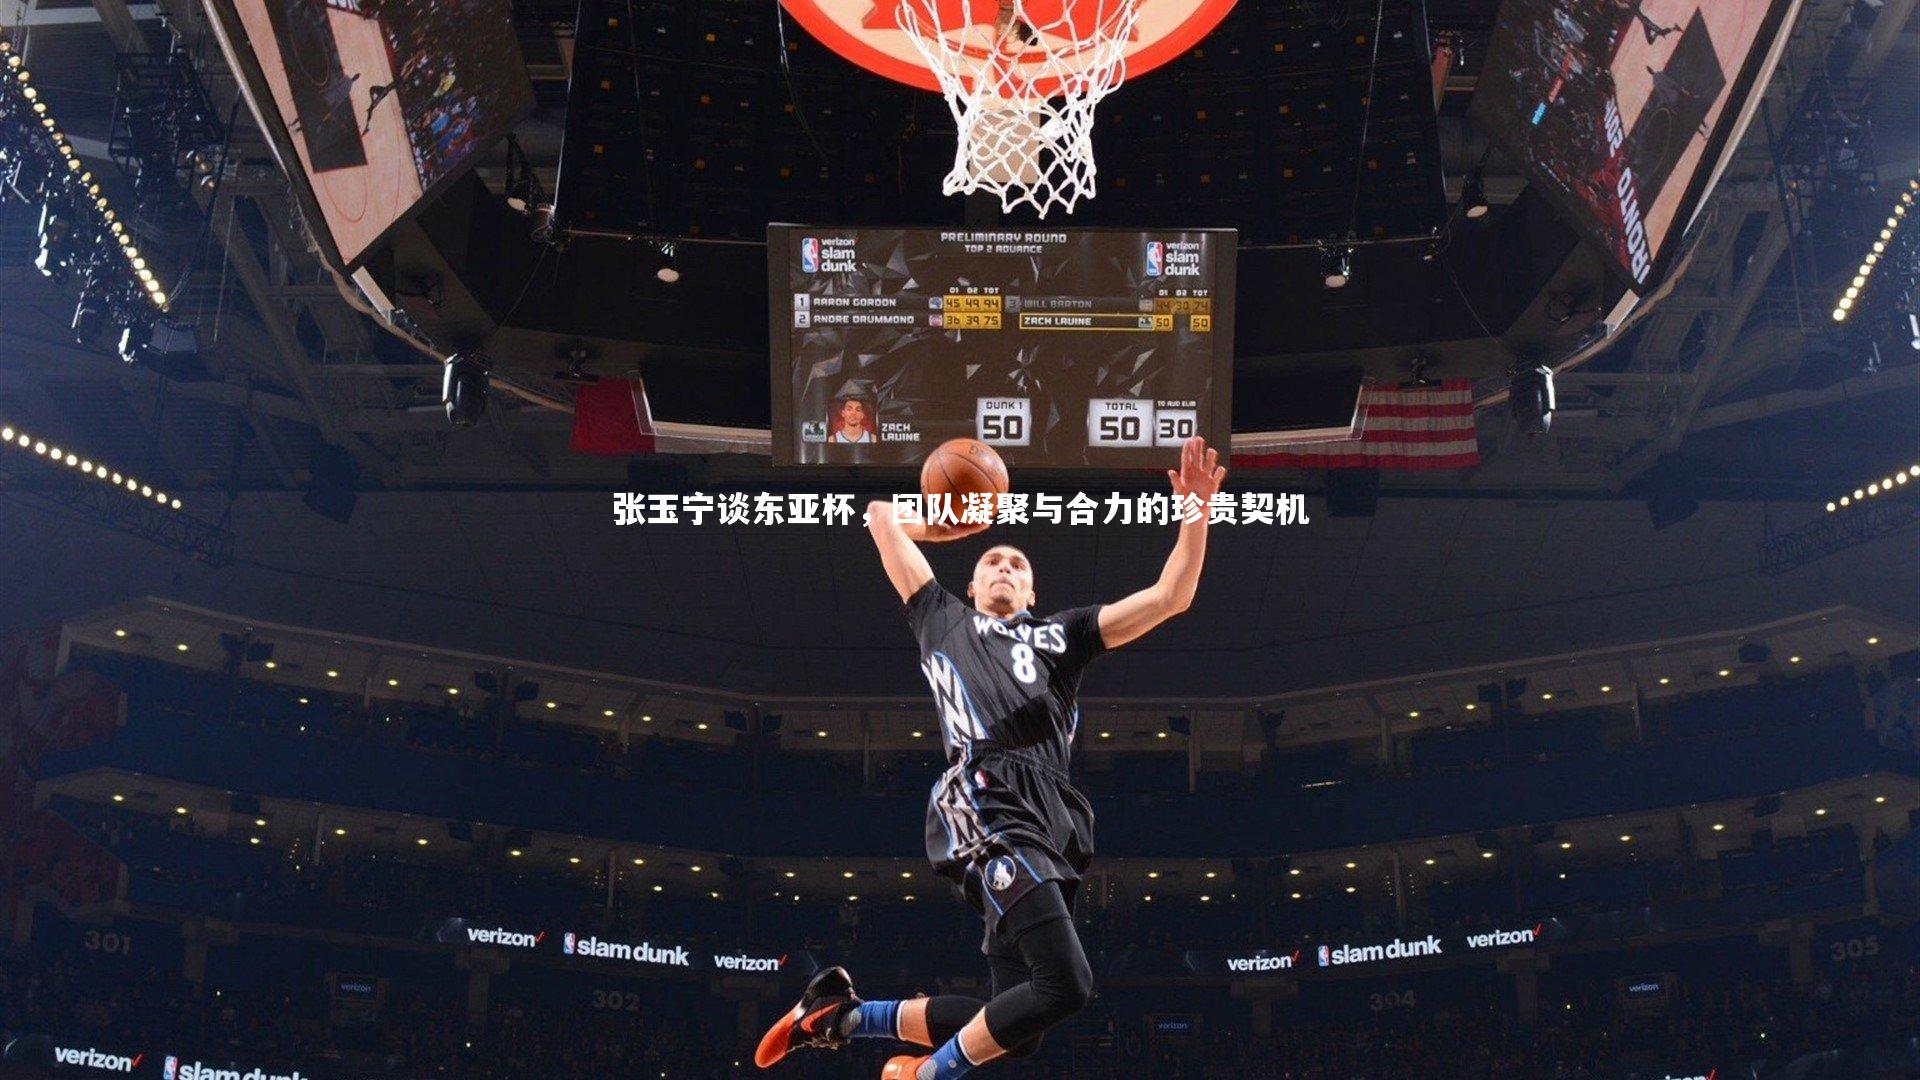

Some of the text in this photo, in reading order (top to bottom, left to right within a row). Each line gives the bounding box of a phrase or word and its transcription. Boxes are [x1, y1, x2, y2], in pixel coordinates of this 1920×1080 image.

[821, 238, 855, 246] verizon
[940, 232, 1067, 243] PRELIMINARY ROUND
[964, 244, 984, 253] TOP
[986, 245, 993, 253] 2
[1165, 242, 1200, 250] verizon
[821, 247, 856, 260] slam
[1165, 251, 1200, 263] slam
[821, 261, 857, 272] dunk
[1165, 264, 1200, 276] dunk
[799, 297, 999, 308] 1 AARON GORDON 45 49 94
[1024, 300, 1047, 308] WILL
[1050, 300, 1092, 308] BARTON
[798, 314, 806, 324] 2
[813, 315, 849, 324] ANDRE
[853, 315, 915, 324] DRUMMOND
[966, 316, 979, 325] 39
[984, 316, 999, 325] 75
[1024, 317, 1052, 325] ZACH
[1156, 318, 1170, 327] 50
[1193, 318, 1208, 327] 50
[986, 401, 1023, 410] DUNK 1
[1105, 402, 1138, 411] TOTAL
[881, 422, 911, 431] ZACH
[983, 415, 1023, 440] 50
[1100, 416, 1140, 441] 50
[1159, 418, 1193, 438] 30
[972, 615, 1067, 654] WOLVES
[1010, 643, 1037, 684] 8
[85, 929, 131, 955] 301
[467, 927, 779, 972] verizon slam dunk verizon
[1227, 928, 1535, 972] verizon slam dunk verizon
[1830, 935, 1880, 961] 305
[341, 983, 371, 992] verizon
[1628, 983, 1660, 992] verizon
[591, 988, 640, 1012] 302
[55, 1046, 132, 1072] verizon
